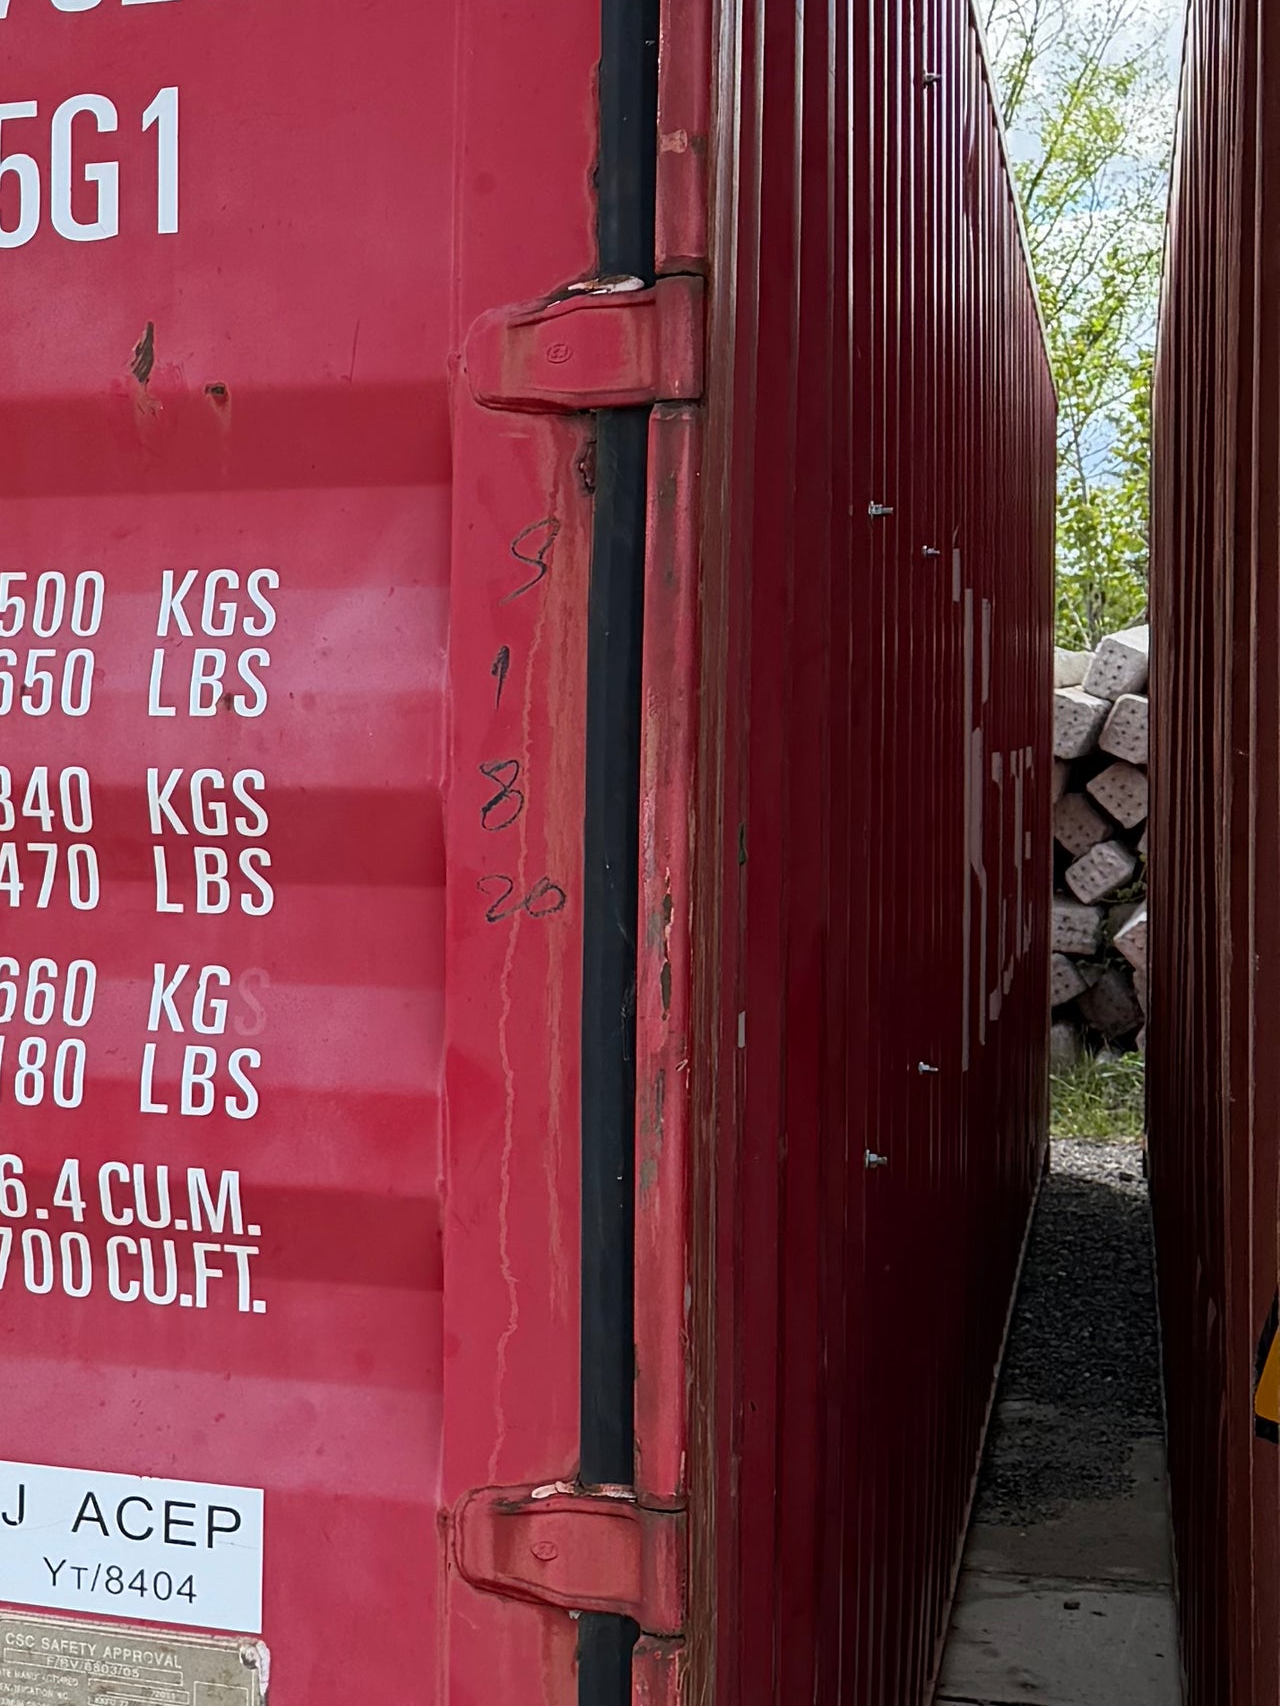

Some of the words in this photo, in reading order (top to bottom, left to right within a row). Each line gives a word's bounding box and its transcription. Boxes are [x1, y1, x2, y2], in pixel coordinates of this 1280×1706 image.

[156, 568, 281, 637] KGS
[147, 649, 271, 718] LBS
[146, 768, 270, 838] KGS
[154, 848, 275, 916] LBS
[139, 1045, 262, 1119] LBS
[98, 1162, 262, 1236] CU.M.
[104, 1236, 267, 1313] CU.FT.
[2, 1483, 25, 1526] J
[71, 1492, 242, 1549] ACEP
[5, 1633, 35, 1647] CSC
[41, 1638, 96, 1656] SAFETY
[103, 1646, 182, 1668] APPROVAL
